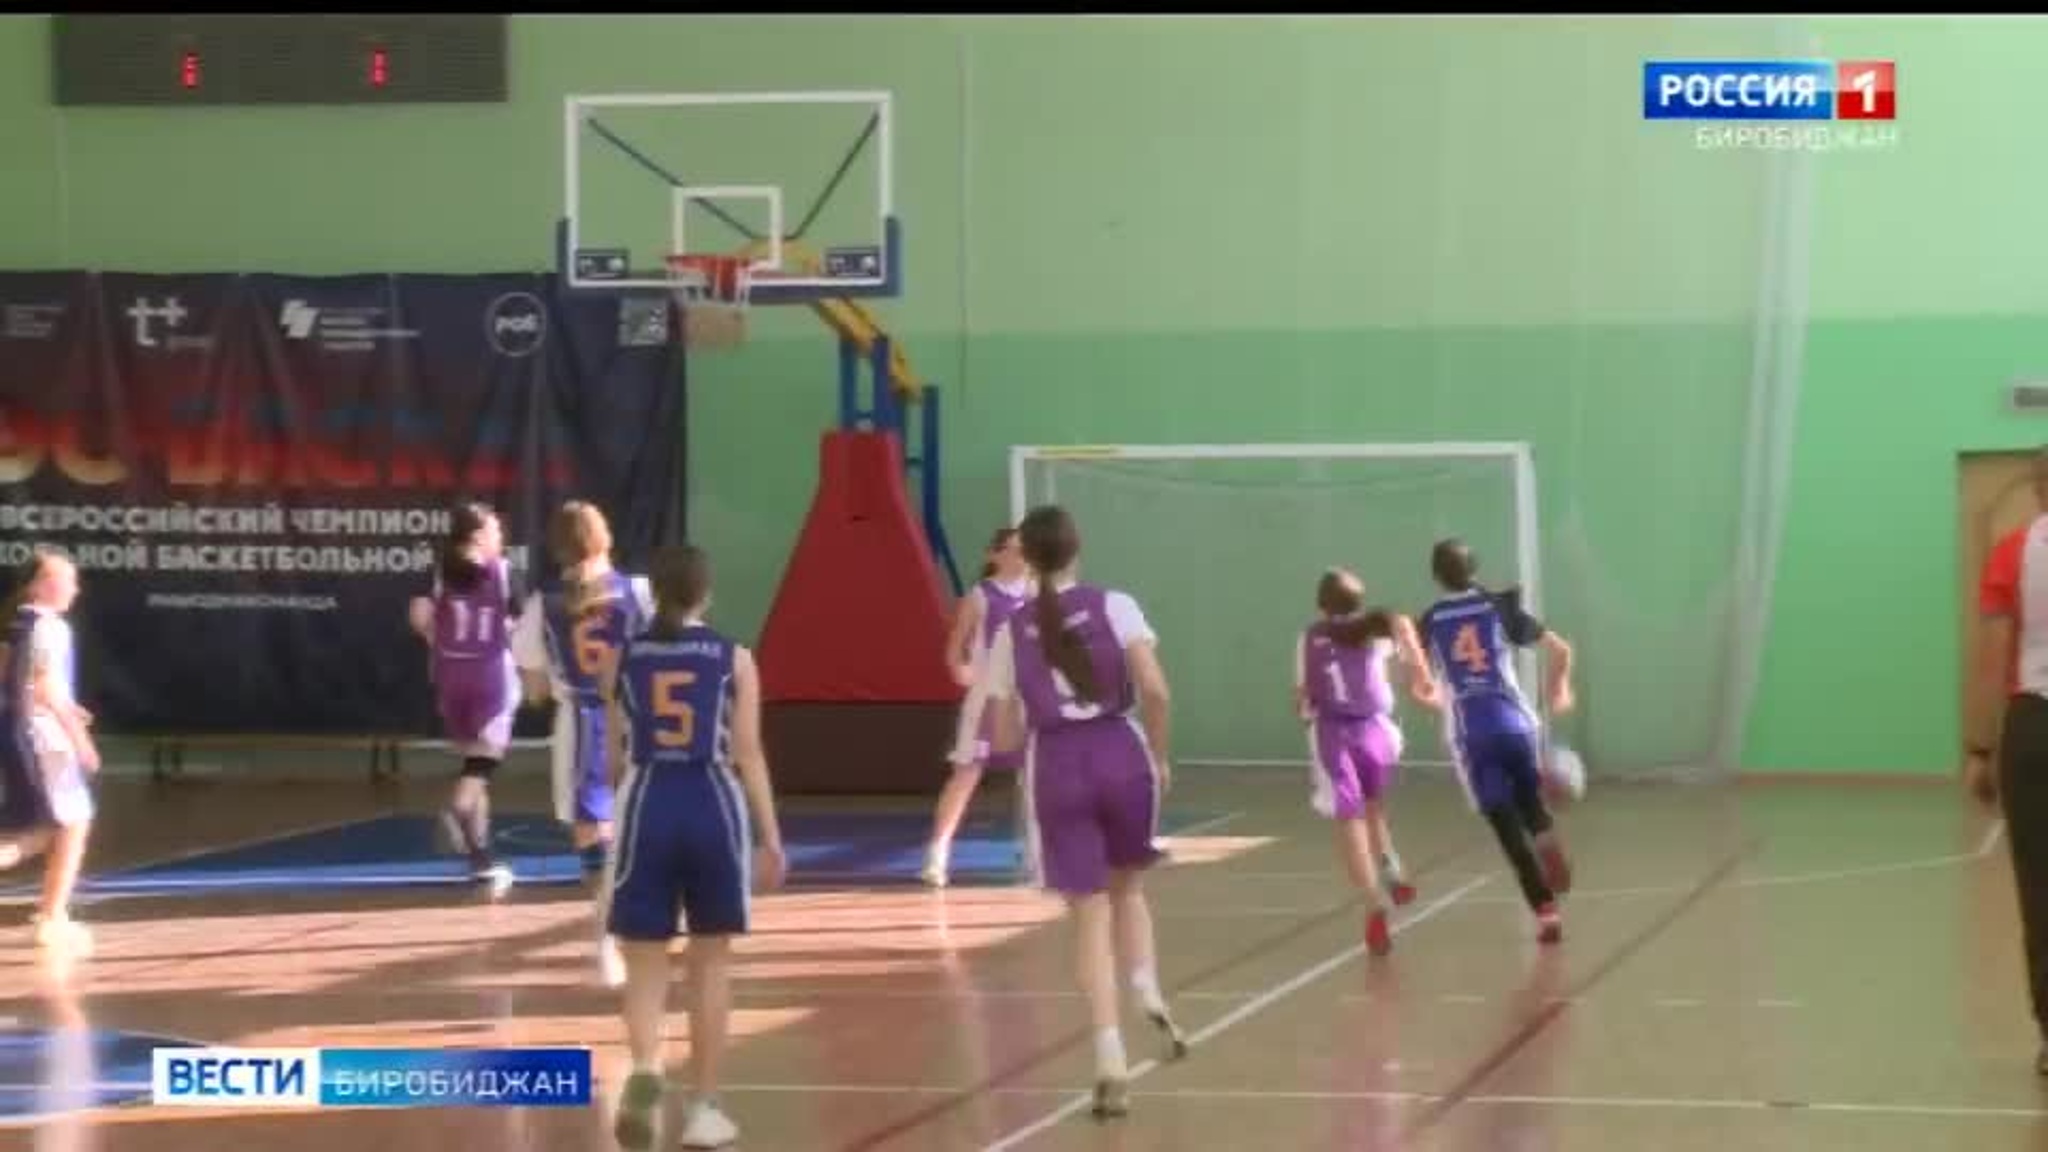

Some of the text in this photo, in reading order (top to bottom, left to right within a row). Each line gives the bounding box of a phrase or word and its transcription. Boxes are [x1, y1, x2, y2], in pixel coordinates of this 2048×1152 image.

[291, 508, 451, 535] ЧЕМПИОН
[157, 540, 434, 573] БАСКЕТБОЛЬНОЙ
[453, 599, 498, 642] 11
[1452, 621, 1489, 674] 4
[1323, 660, 1349, 704] 1
[652, 669, 697, 747] 5
